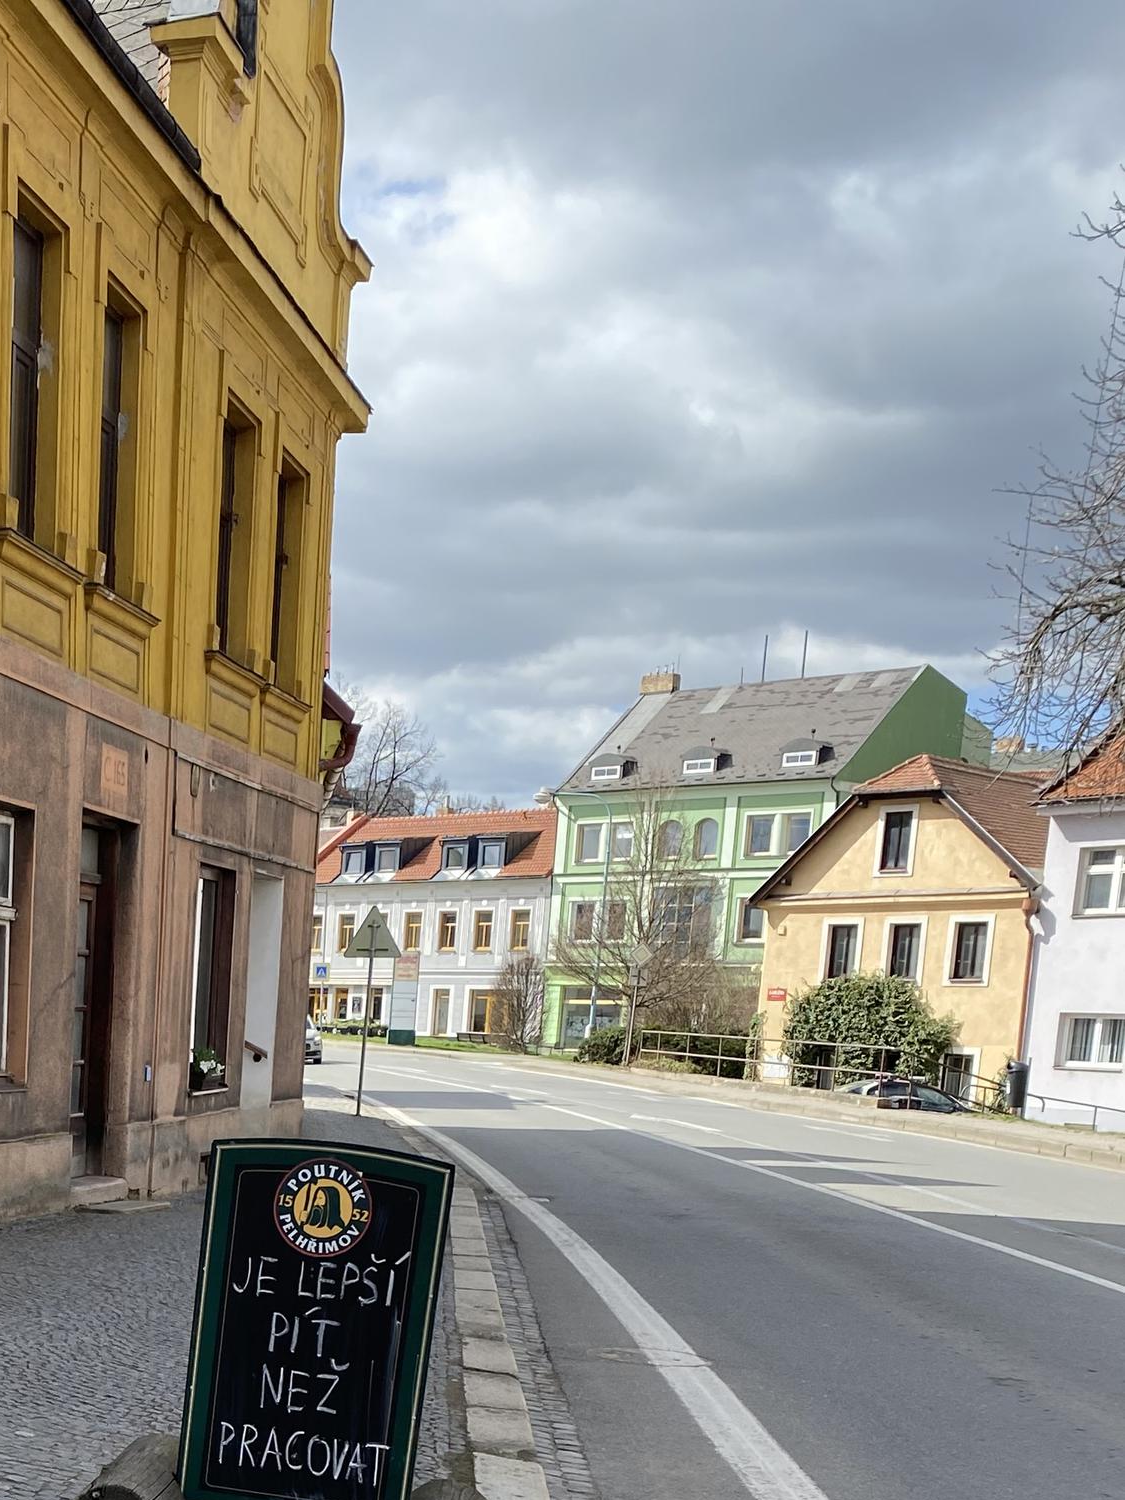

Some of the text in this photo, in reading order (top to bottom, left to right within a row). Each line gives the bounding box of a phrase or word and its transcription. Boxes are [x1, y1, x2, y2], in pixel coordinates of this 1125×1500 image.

[278, 1193, 294, 1208] 15
[287, 1164, 366, 1202] POUTNÍK
[279, 1213, 360, 1254] PELHŘIMOV
[351, 1208, 369, 1222] 52
[232, 1251, 412, 1307] JE LEPŠÍ
[268, 1305, 341, 1358] PÍT
[259, 1358, 350, 1415] NEŽ
[218, 1420, 391, 1488] PRACOVAT
